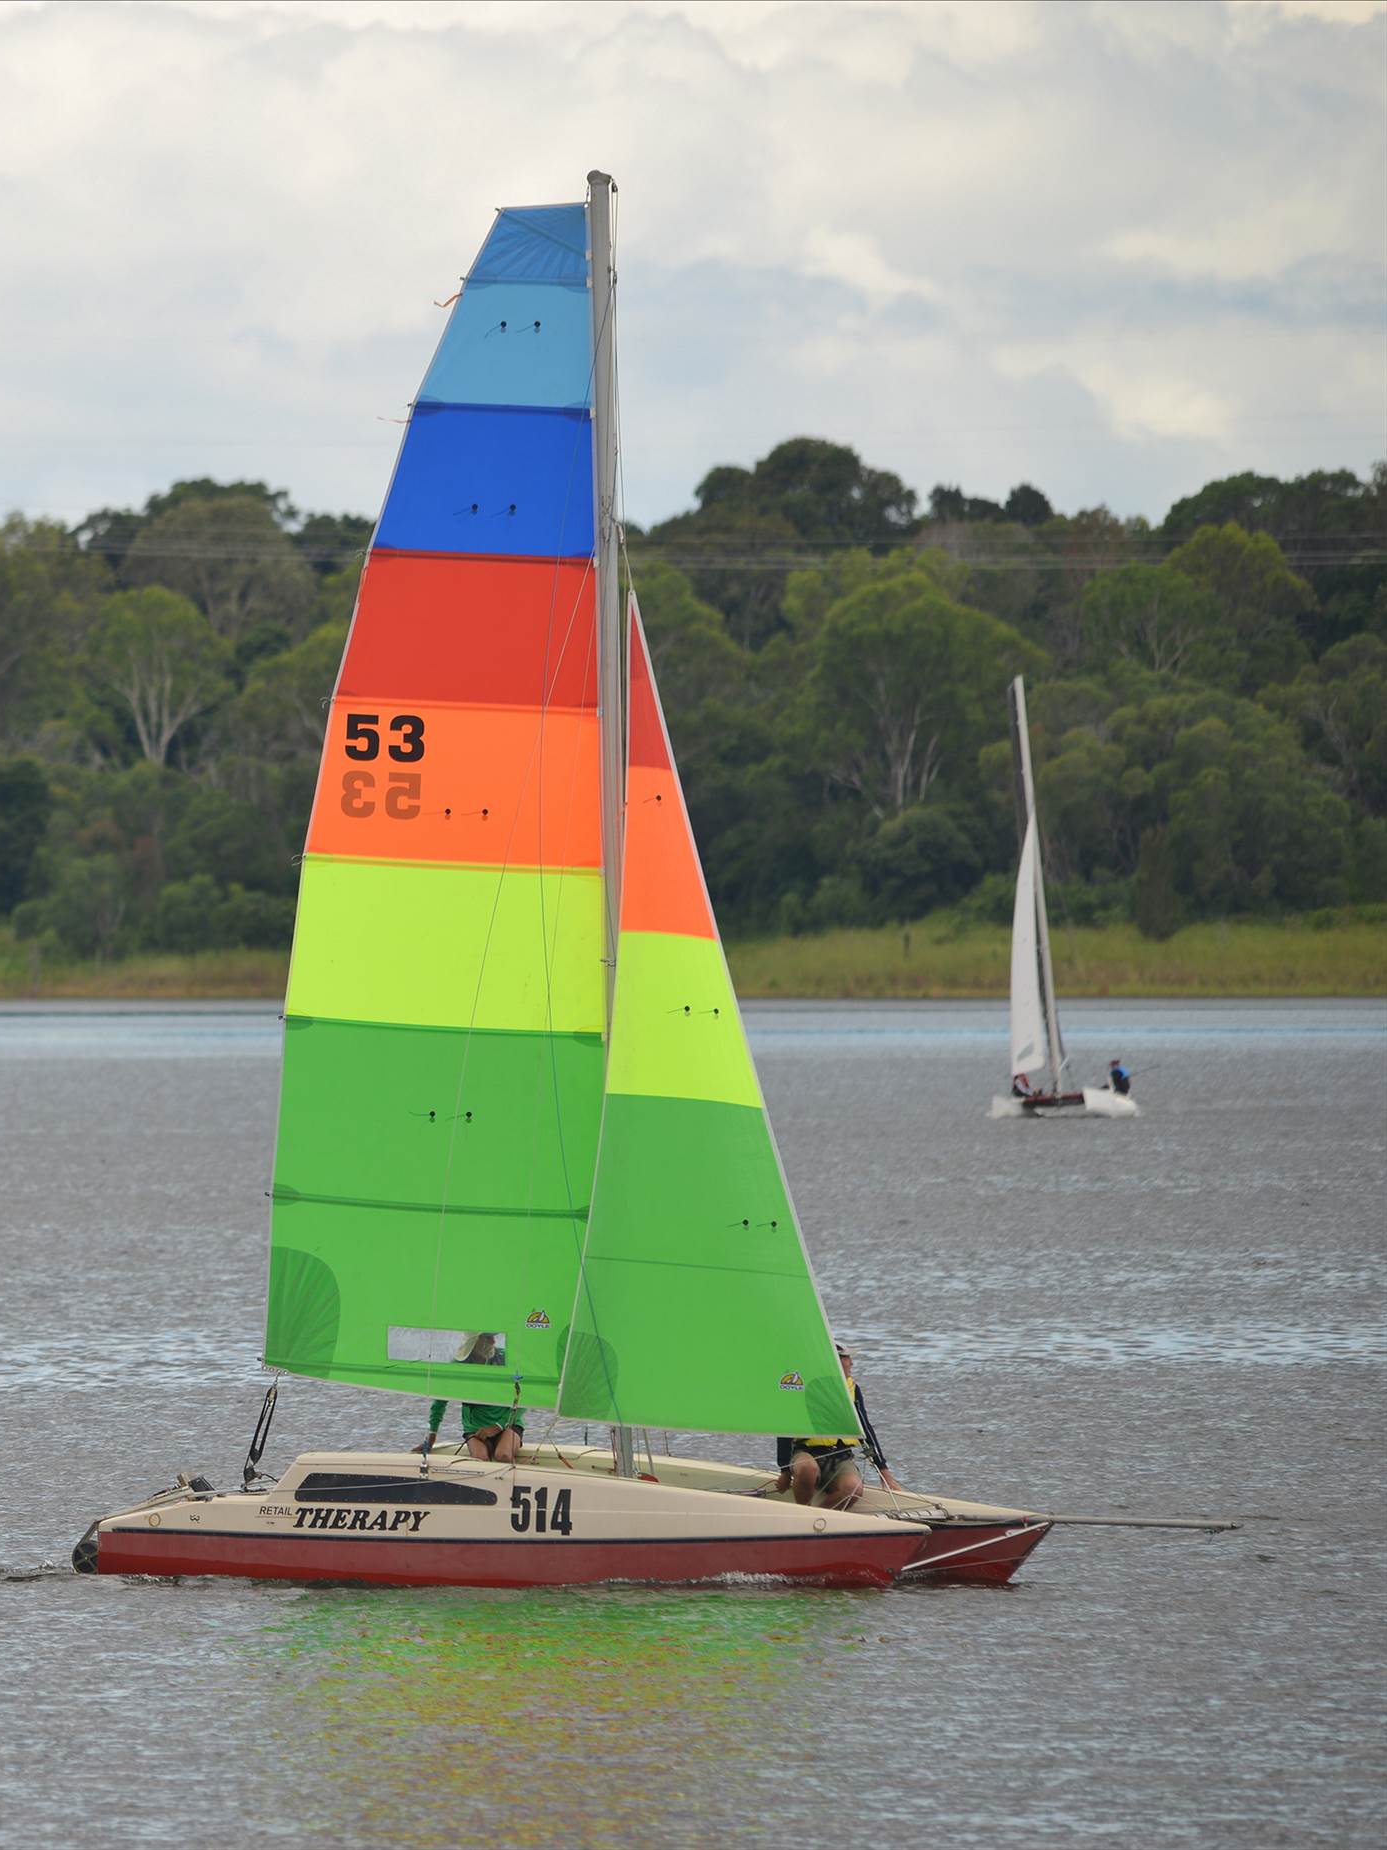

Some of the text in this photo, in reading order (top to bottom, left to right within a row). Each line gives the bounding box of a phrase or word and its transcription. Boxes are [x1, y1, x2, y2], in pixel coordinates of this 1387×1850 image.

[345, 713, 425, 763] 53
[259, 1505, 431, 1532] RETAIL THERAPY
[510, 1485, 573, 1536] 514
